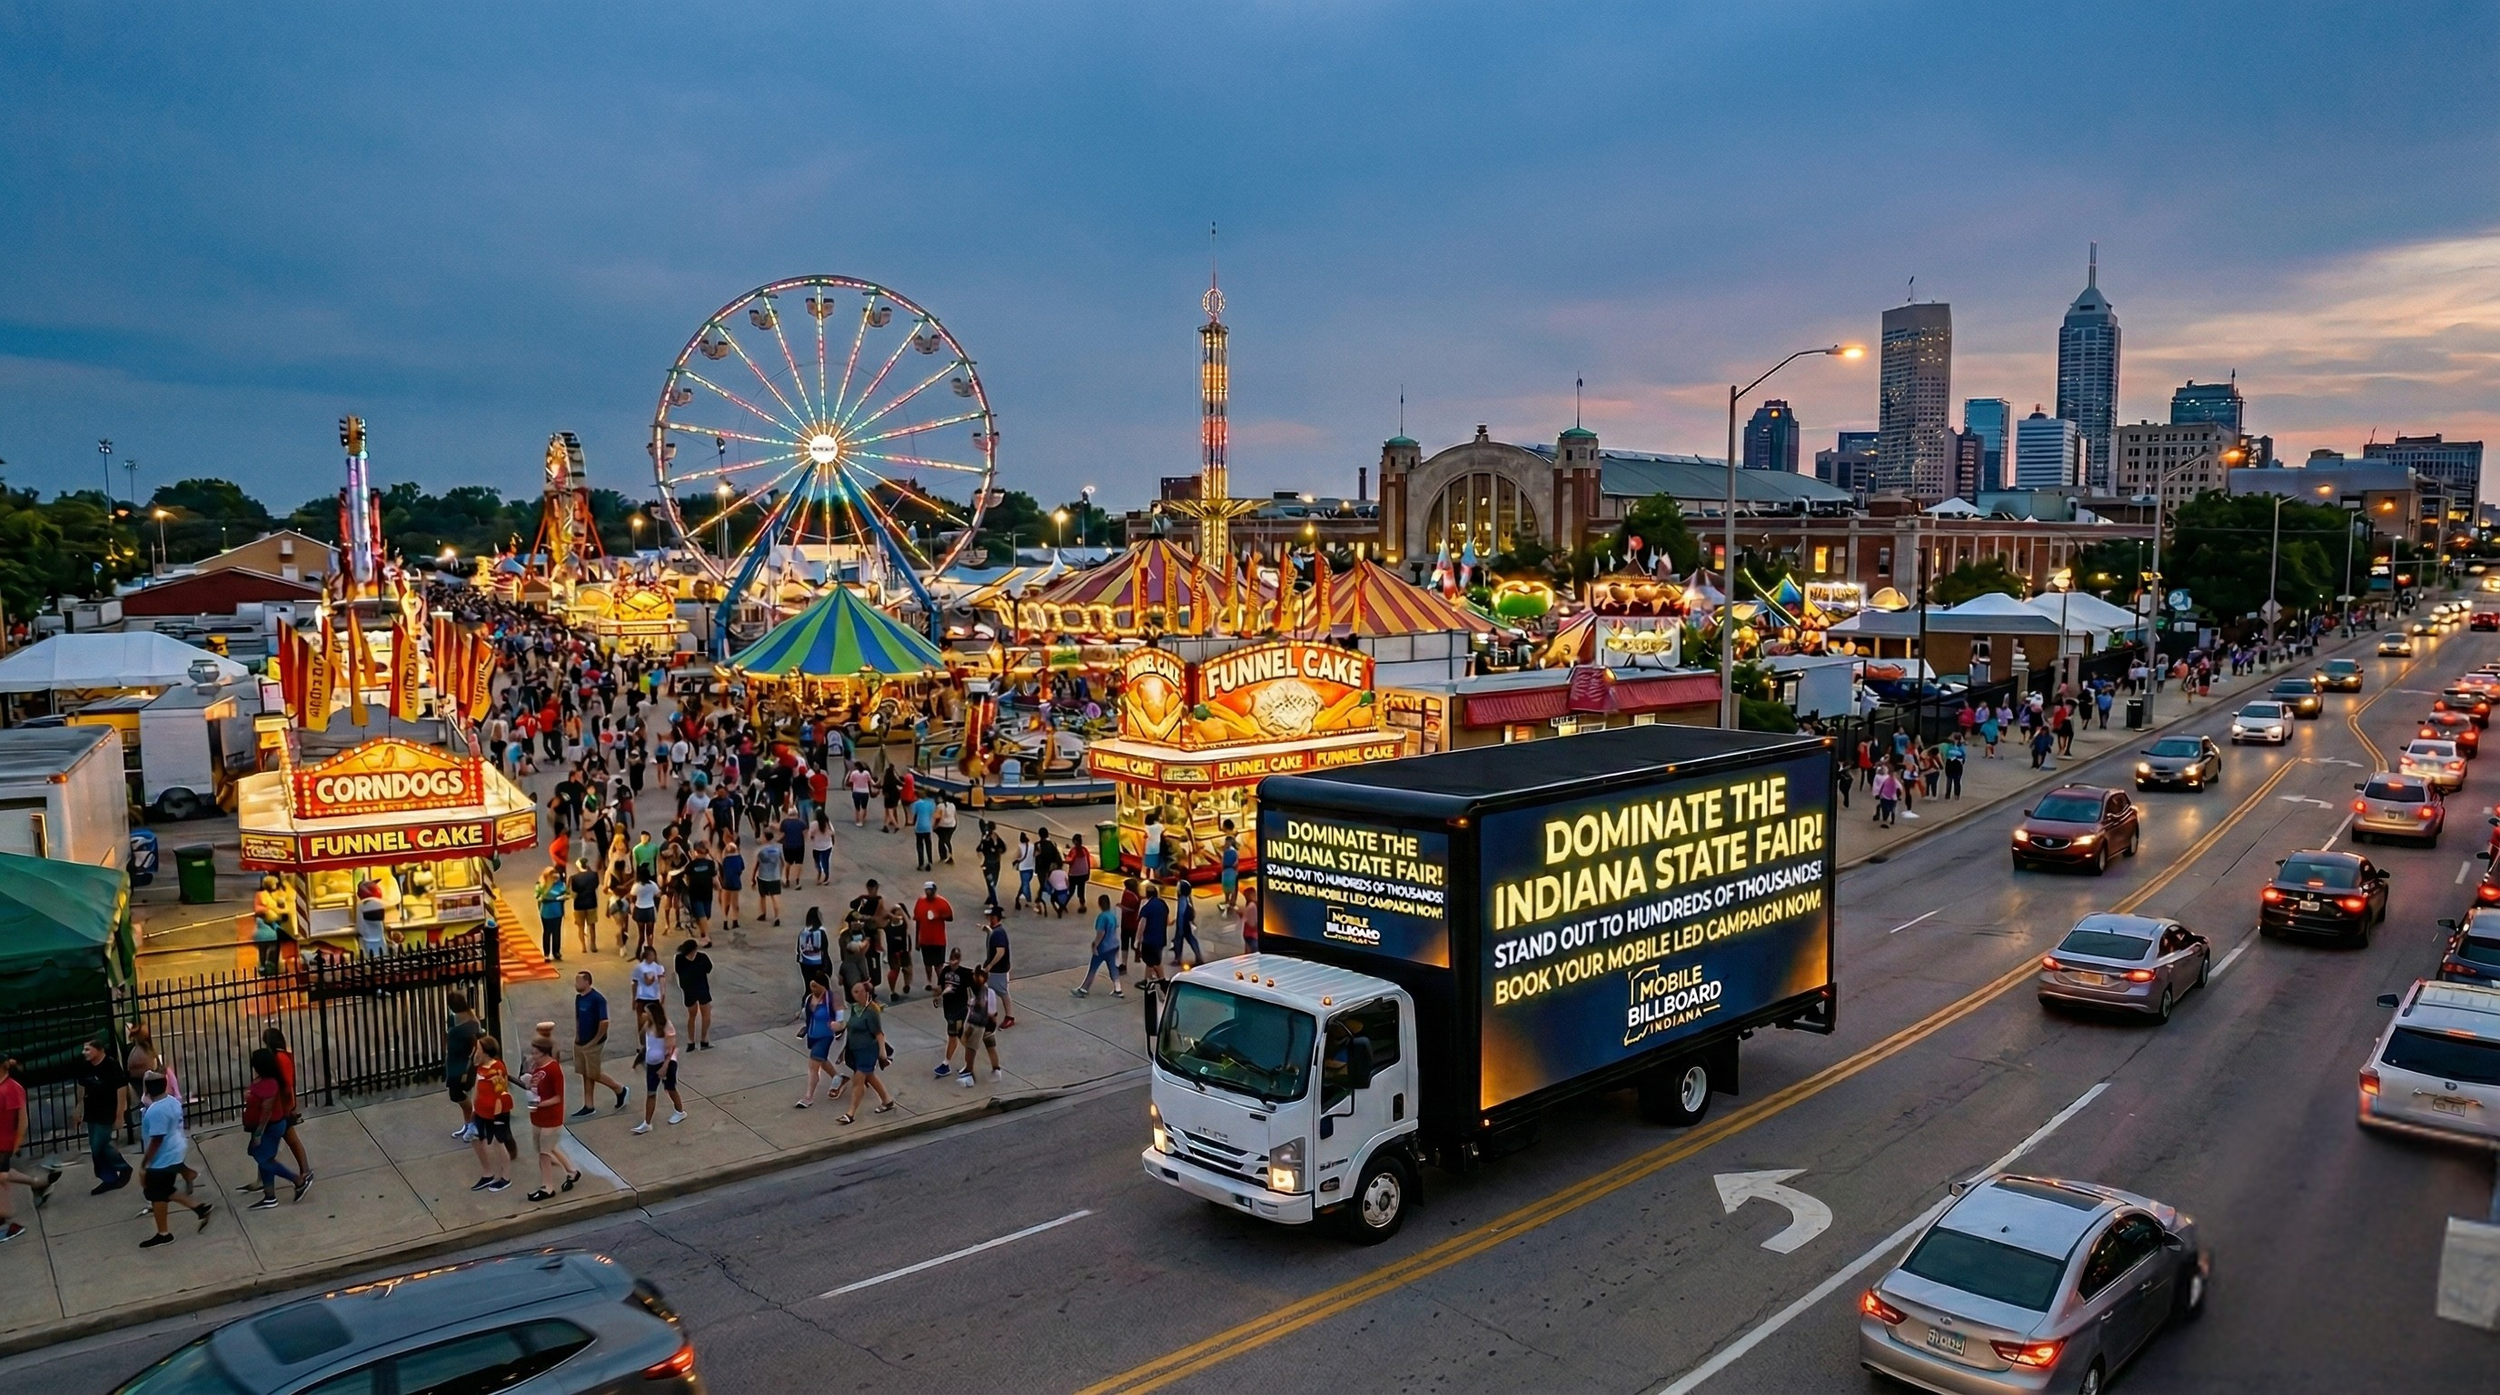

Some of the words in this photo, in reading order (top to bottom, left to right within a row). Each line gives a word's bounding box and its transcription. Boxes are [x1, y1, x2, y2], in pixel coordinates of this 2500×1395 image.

[1205, 650, 1299, 698] FUNNEL
[1302, 648, 1362, 687] CAKE
[1219, 759, 1266, 778] FUNNEL
[1270, 755, 1303, 771] CAKE
[1317, 748, 1362, 766] FUNNEL
[1364, 745, 1395, 760] CAKE
[316, 770, 464, 803] CORNDOGS
[1287, 820, 1378, 851] DOMINATE
[1381, 834, 1418, 857] THE
[1545, 789, 1723, 864] DOMINATE
[1730, 777, 1786, 822] THE
[310, 831, 411, 858] FUNNEL
[417, 824, 483, 848] CAKE
[1267, 840, 1336, 869] INDIANA
[1339, 851, 1392, 877] STATE
[1396, 860, 1443, 886] FAIR!
[1495, 856, 1648, 930] INDIANA
[1655, 830, 1747, 889] STATE
[1756, 814, 1823, 864] FAIR!
[1266, 864, 1294, 878] STAND
[1295, 868, 1311, 881] OUT
[1312, 871, 1325, 883] TO
[1373, 881, 1385, 894] OF
[1386, 883, 1444, 904] THOUSANDS!
[1268, 879, 1293, 893] BOOK
[1350, 892, 1367, 906] LED
[1416, 903, 1443, 919] NOW!
[1494, 932, 1557, 969] STAND
[1560, 923, 1597, 950] OUT
[1599, 916, 1623, 940] TO
[1627, 889, 1712, 932] HUNDREDS
[1715, 883, 1735, 908] OF
[1735, 860, 1822, 901] THOUSANDS!
[1495, 967, 1551, 1006] BOOK
[1554, 953, 1604, 988] YOUR
[1607, 933, 1670, 971] MOBILE
[1674, 924, 1703, 951] LED
[1706, 901, 1783, 941] CAMPAIGN
[1785, 889, 1822, 918] NOW!
[1639, 965, 1702, 1001] MOBILE
[1628, 981, 1722, 1027] BILLBOARD
[1650, 1009, 1702, 1034] INDIANA
